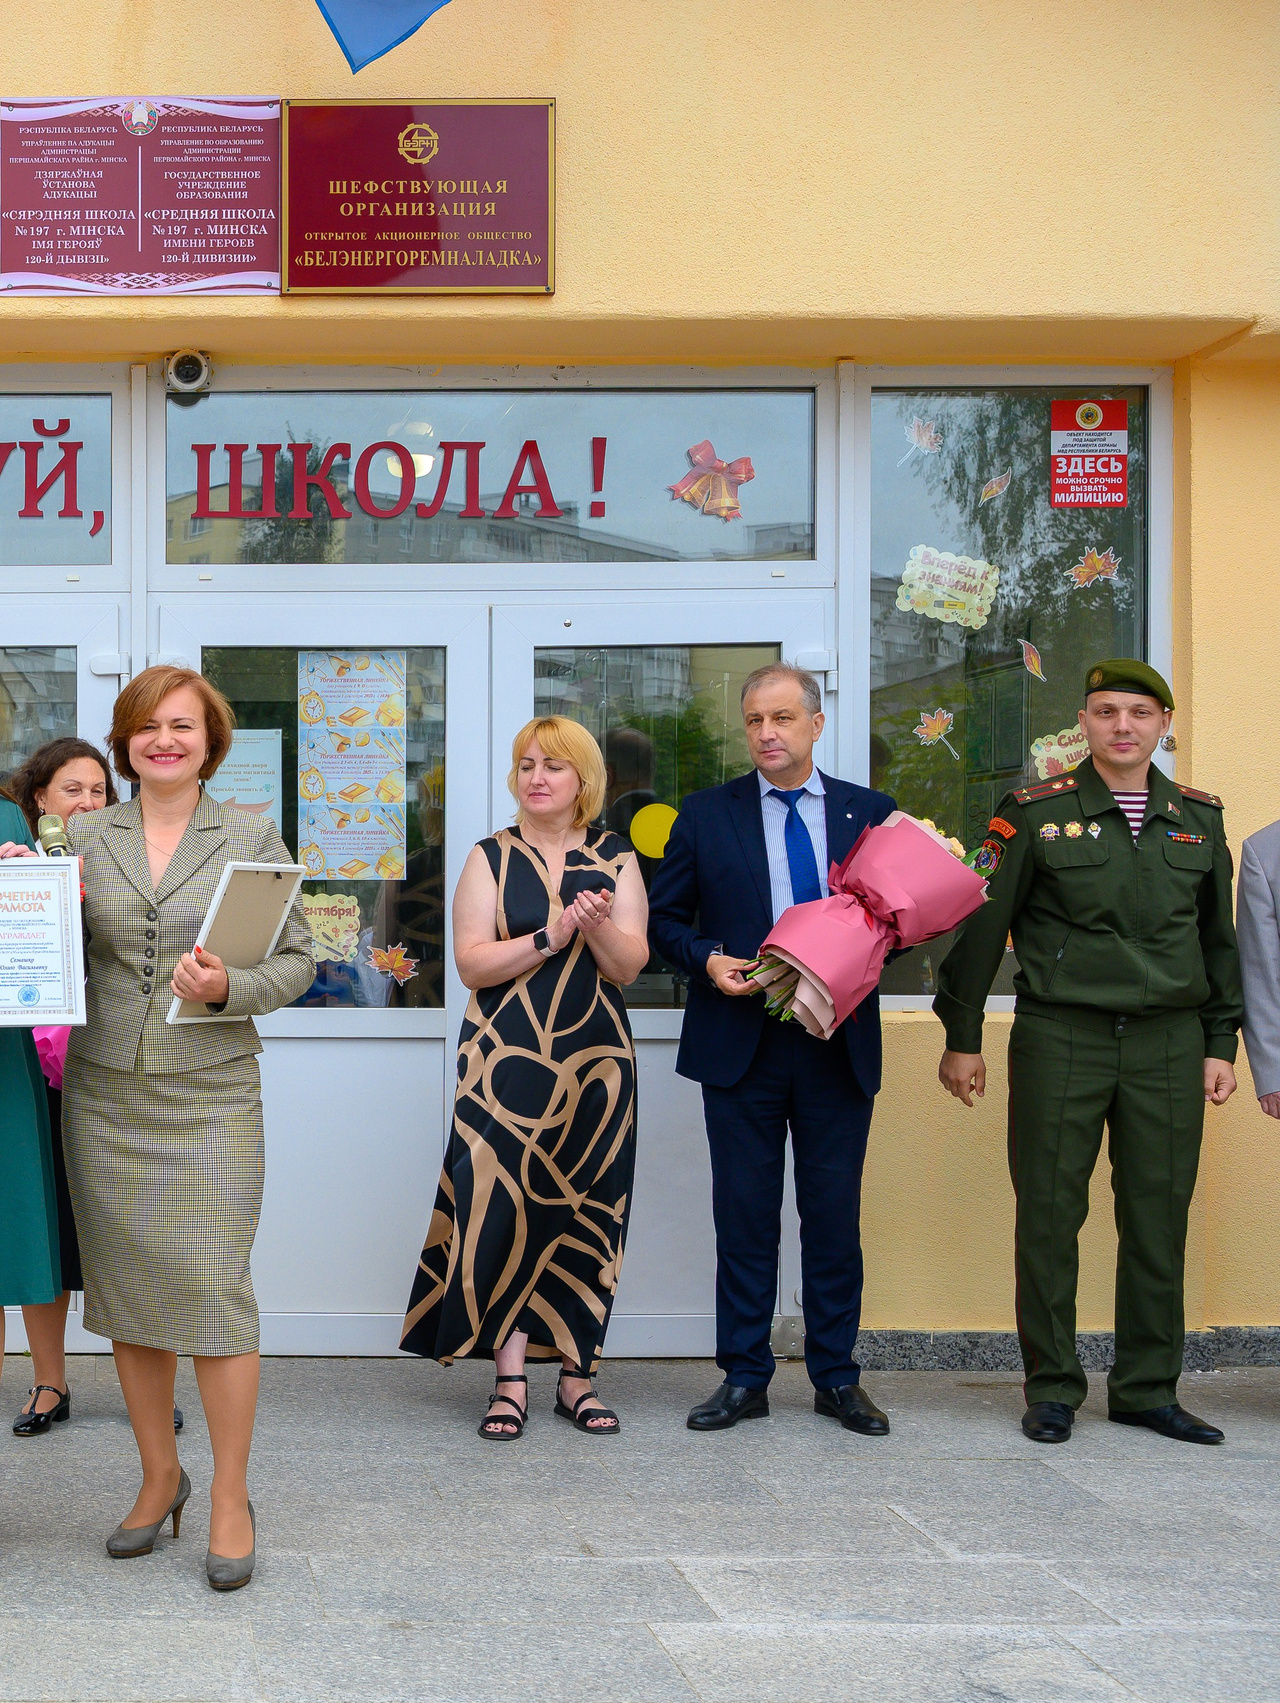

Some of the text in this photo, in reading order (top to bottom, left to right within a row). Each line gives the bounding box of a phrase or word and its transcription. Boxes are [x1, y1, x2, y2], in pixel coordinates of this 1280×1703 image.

[219, 125, 264, 133] БЕЛАРУСЬ
[21, 139, 67, 147] УПРАЎЛЕННЕ
[34, 169, 104, 181] ДЗЯРЖАЎНАЯ
[163, 170, 261, 181] ГОСУДАРСТВЕННОЕ
[42, 177, 96, 189] ЎСТАНОВА
[178, 180, 247, 190] УЧРЕЖДЕНИЕ
[328, 180, 508, 196] ШЕФСТВУЮЩАЯ
[42, 190, 98, 200] АДУКАЦЫІ
[176, 190, 248, 200] ОБРАЗОВАНИЯ
[1, 209, 136, 221] «СЯРЭДНЯЯ ШКОЛА
[144, 208, 276, 221] «СРЕДНЯЯ ШКОЛА
[339, 202, 497, 217] ОРГАНИЗАЦИЯ
[56, 228, 66, 236] г.
[69, 225, 126, 236] МІНСКА
[207, 224, 268, 235] МИНСКА
[32, 237, 103, 249] ІМЯ ГЕРОЯЎ
[163, 238, 255, 248] ИМЕНИ ГЕРОЕВ
[304, 231, 532, 243] ОТКРЫТОЕ АКЦИОНЕРНОЕ ОБЩЕСТВО
[25, 252, 110, 265] 120-Й ДЫВІЗІІ»
[161, 252, 257, 265] 120-Й ДИВИЗИИ»
[294, 250, 542, 269] «БЕЛЭНЕРГОРЕМНАЛАДКА»
[1055, 457, 1123, 477] ЗДЕСЬ
[1055, 477, 1088, 485] МОЖНО
[1054, 492, 1124, 505] МИЛИЦИЮ
[920, 550, 977, 580] Вперёд
[1065, 747, 1091, 765] шко
[304, 905, 356, 920] ентября!
